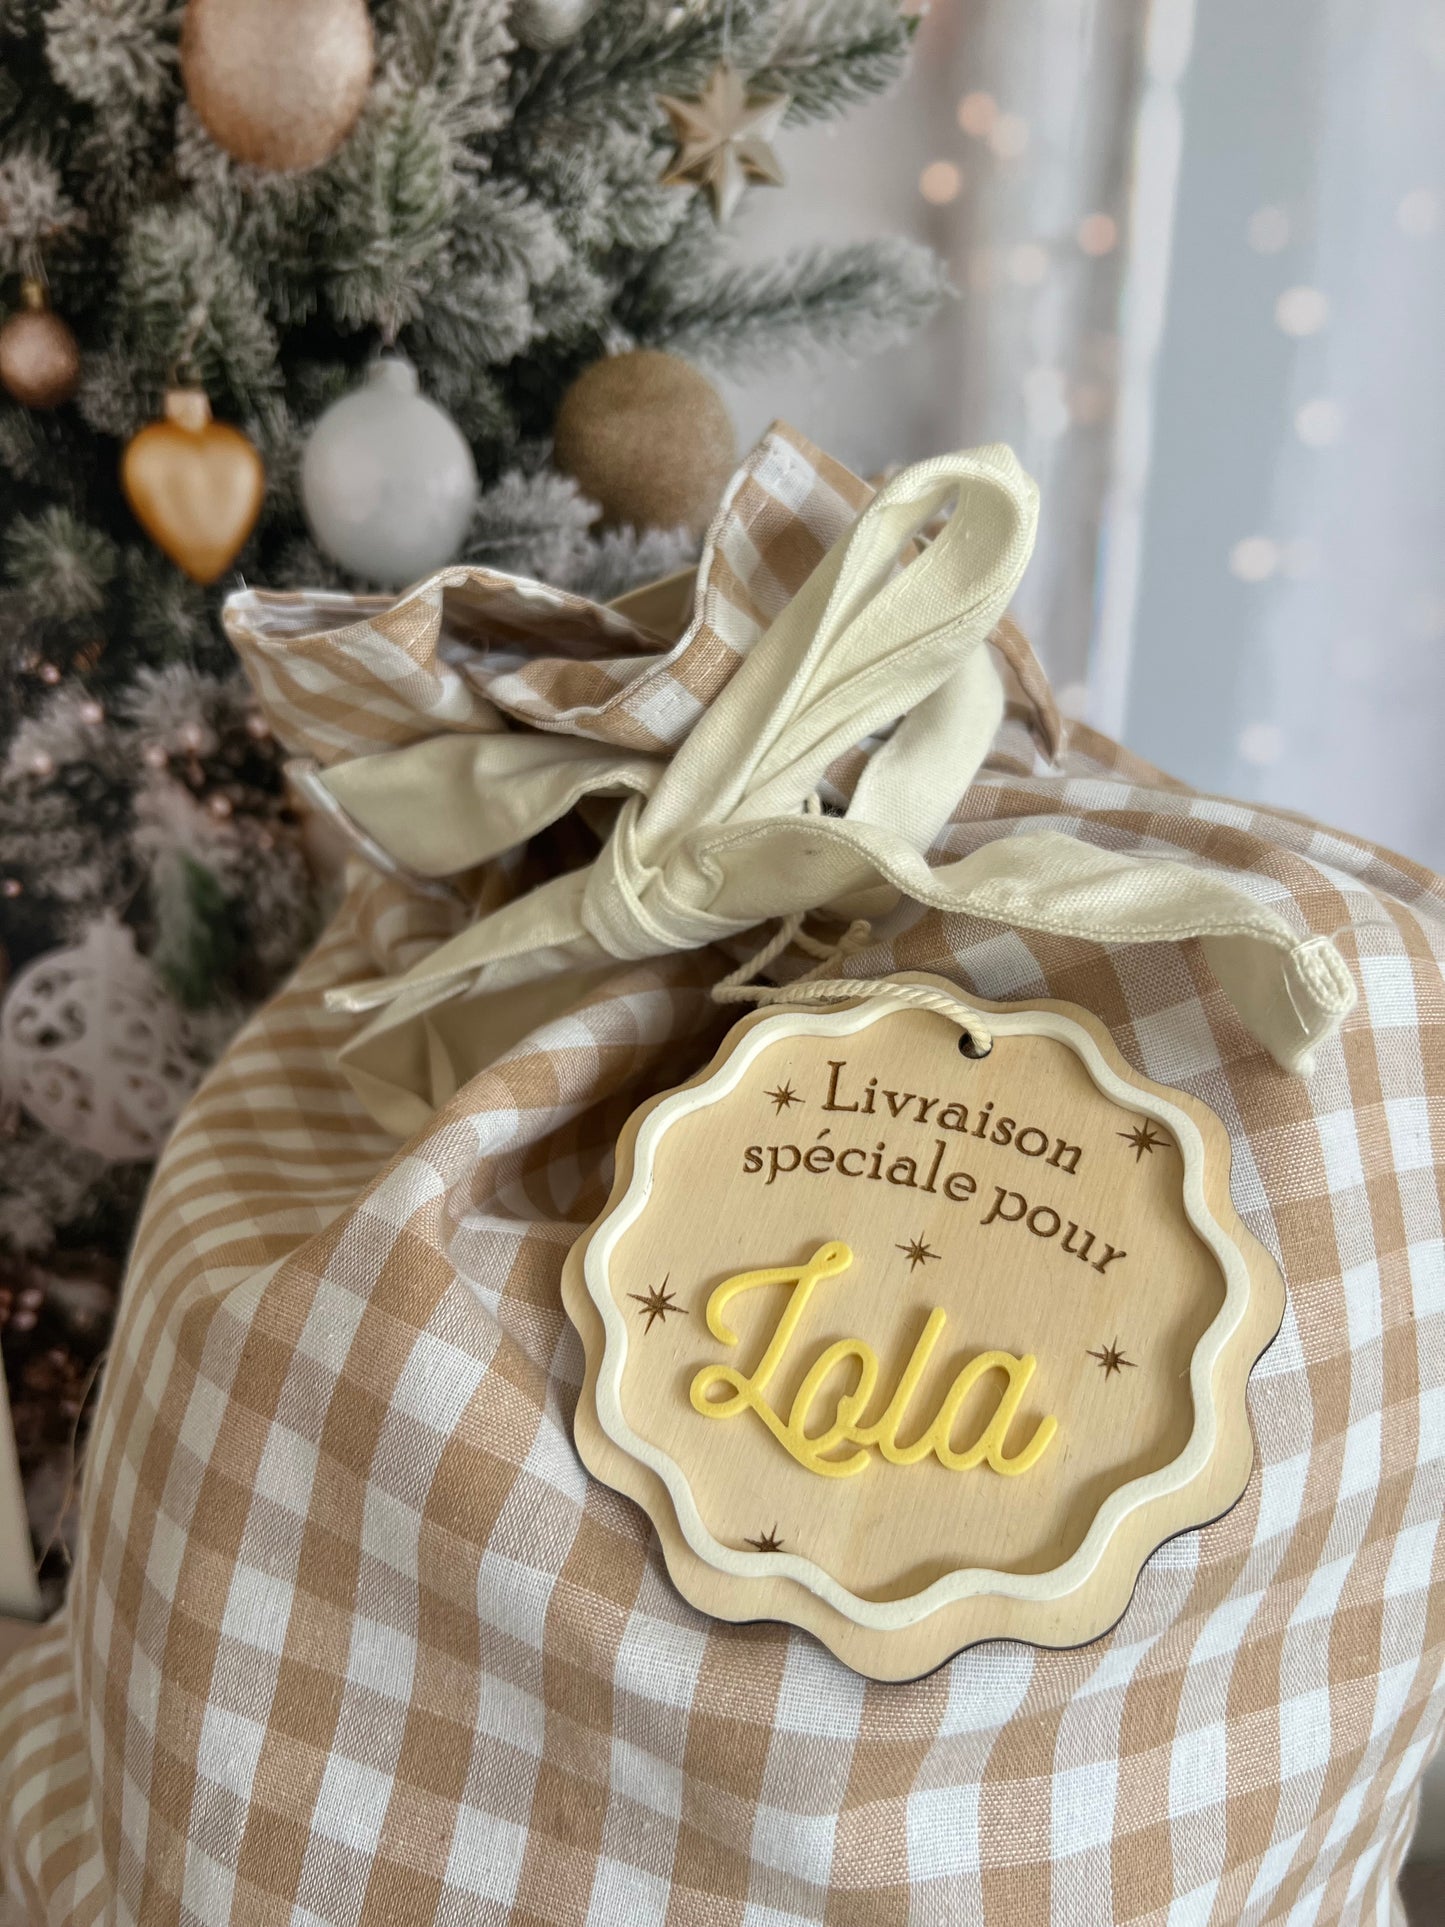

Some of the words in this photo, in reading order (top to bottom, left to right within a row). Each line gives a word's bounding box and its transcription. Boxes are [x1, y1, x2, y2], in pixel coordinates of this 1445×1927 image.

[821, 1060, 1082, 1175] Livraison
[742, 1128, 977, 1202] spéciale
[980, 1185, 1127, 1275] pour
[689, 1240, 1059, 1478] Lola
